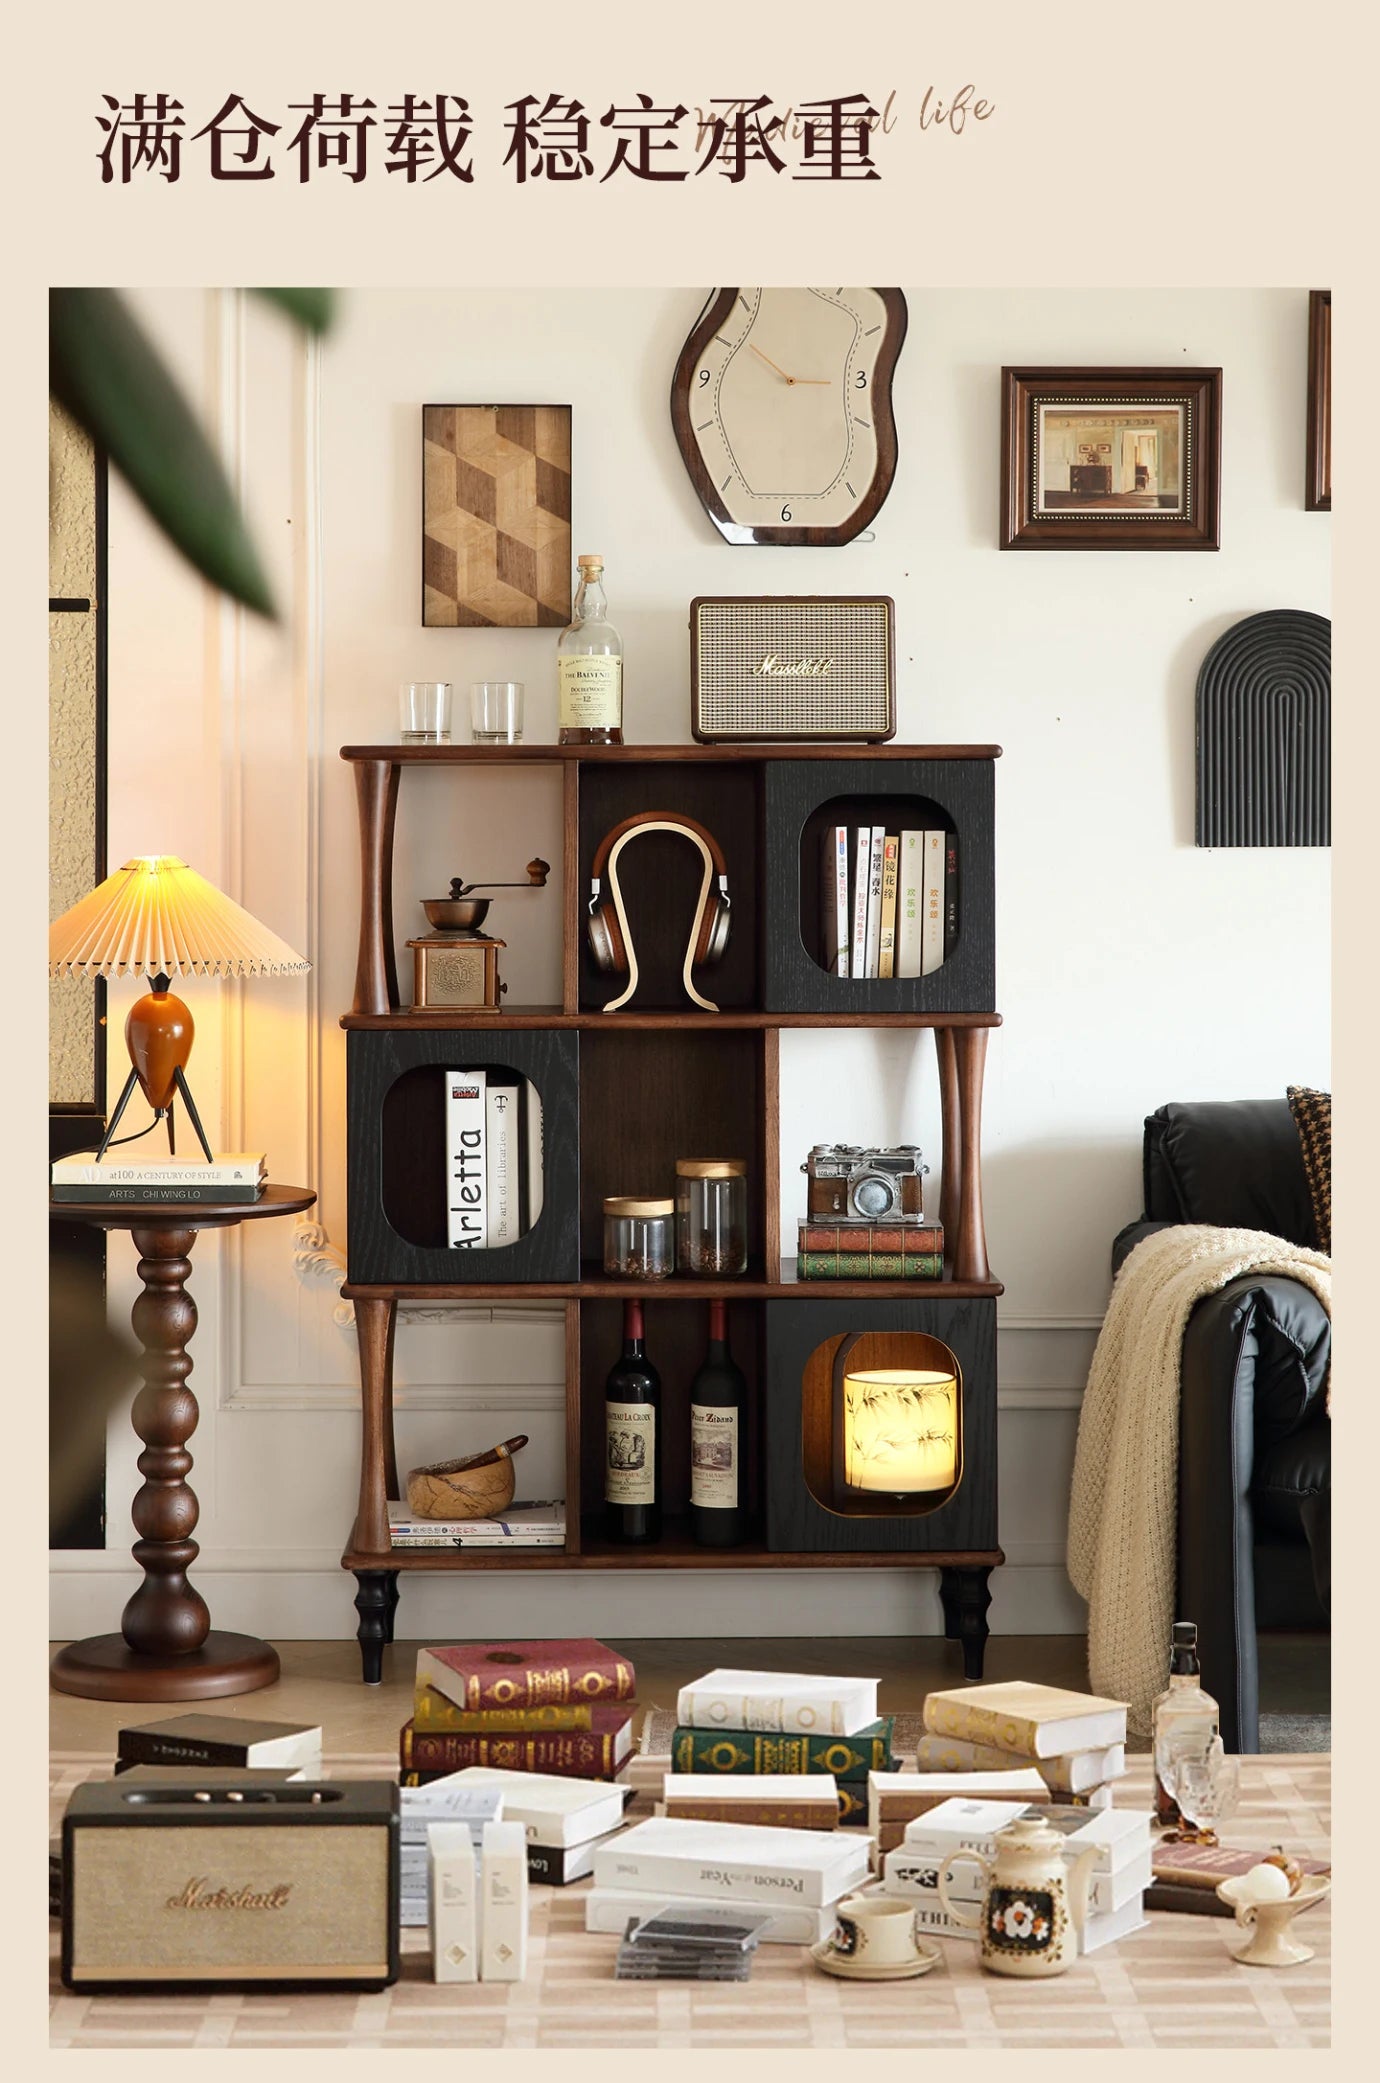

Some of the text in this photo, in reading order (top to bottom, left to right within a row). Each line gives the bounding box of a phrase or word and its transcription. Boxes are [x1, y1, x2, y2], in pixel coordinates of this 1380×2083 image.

[699, 370, 711, 388] 9
[855, 371, 867, 388] 3
[781, 504, 792, 521] 6
[884, 861, 895, 899] 镜花缘
[906, 888, 916, 919] 欢乐颂
[929, 888, 939, 919] 欢乐颂
[144, 1172, 184, 1180] CENTURY
[185, 1172, 197, 1180] OF
[198, 1172, 222, 1180] STYLE
[497, 1131, 507, 1237] The art of libraries
[109, 1190, 201, 1198] ARTS CHI WING LO
[451, 1129, 482, 1248] Arletta
[700, 1870, 731, 1886] Year
[754, 1875, 804, 1893] Person
[166, 1877, 293, 1909] Marshall
